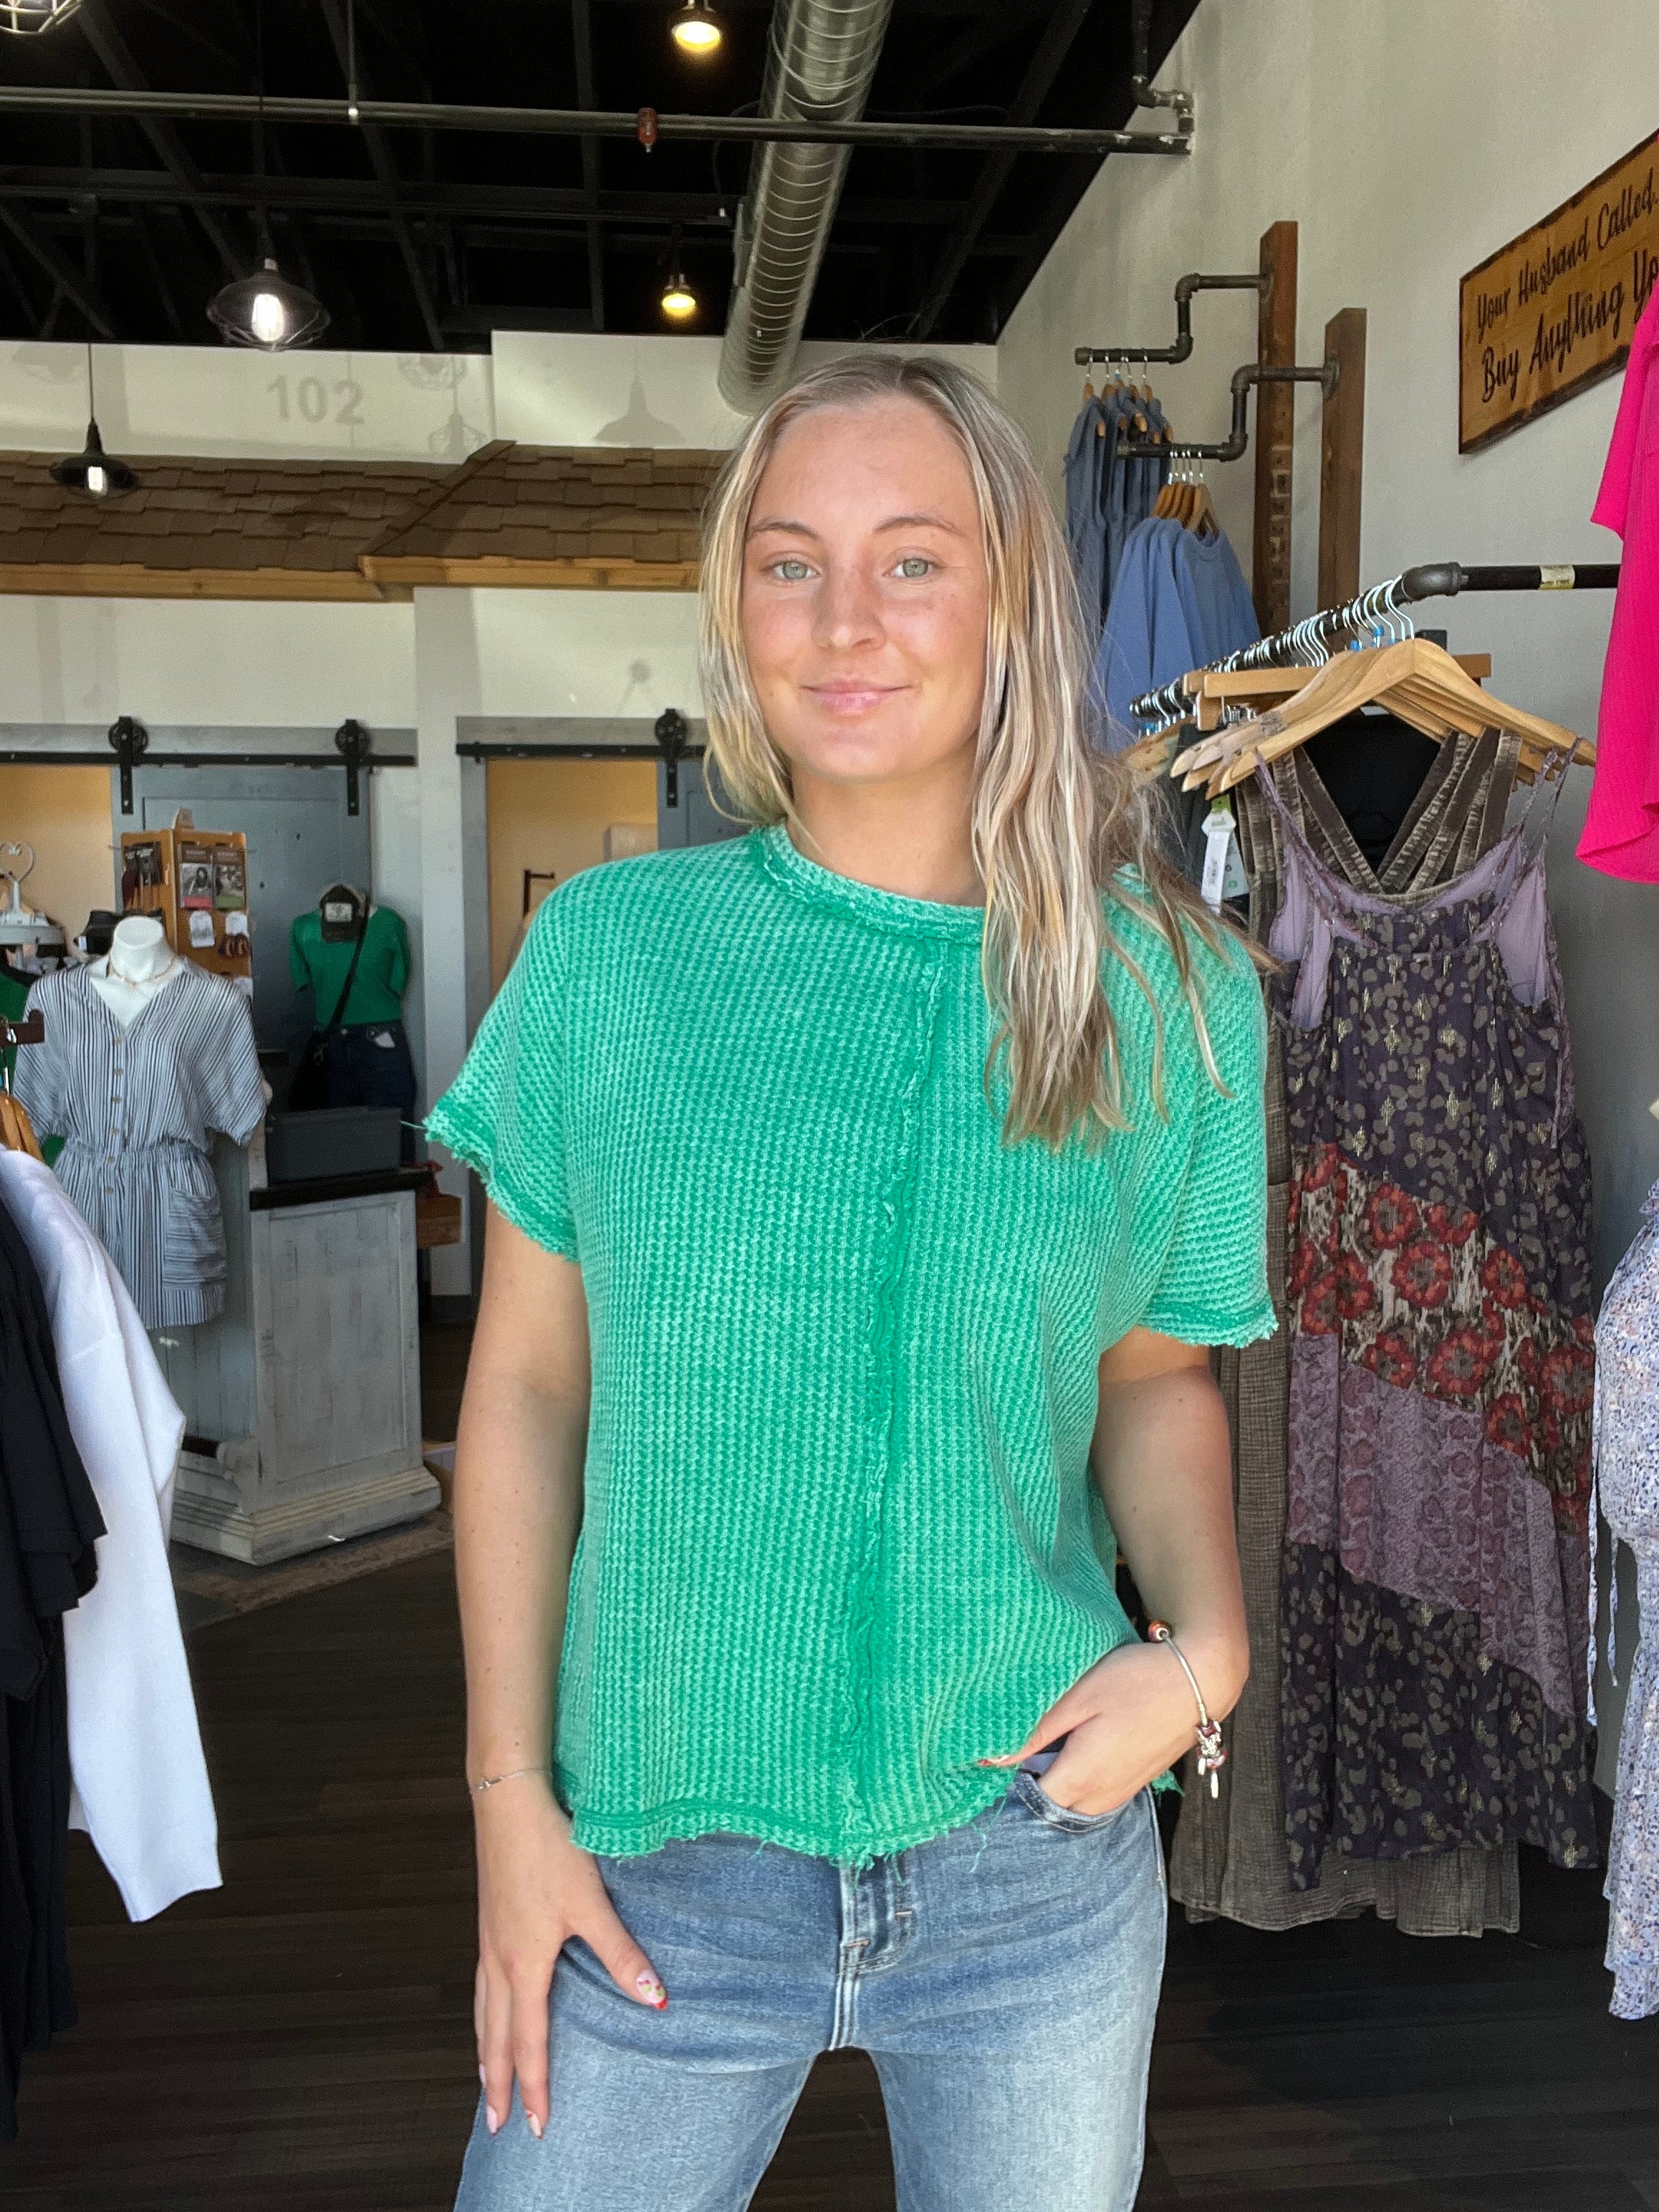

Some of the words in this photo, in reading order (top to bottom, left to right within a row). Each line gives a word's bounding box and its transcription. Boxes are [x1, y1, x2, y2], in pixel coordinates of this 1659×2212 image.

[1476, 287, 1511, 345] Your
[1518, 217, 1590, 307] Husband
[266, 375, 365, 425] 102
[1482, 346, 1520, 403] Buy
[1529, 282, 1624, 374] Anything
